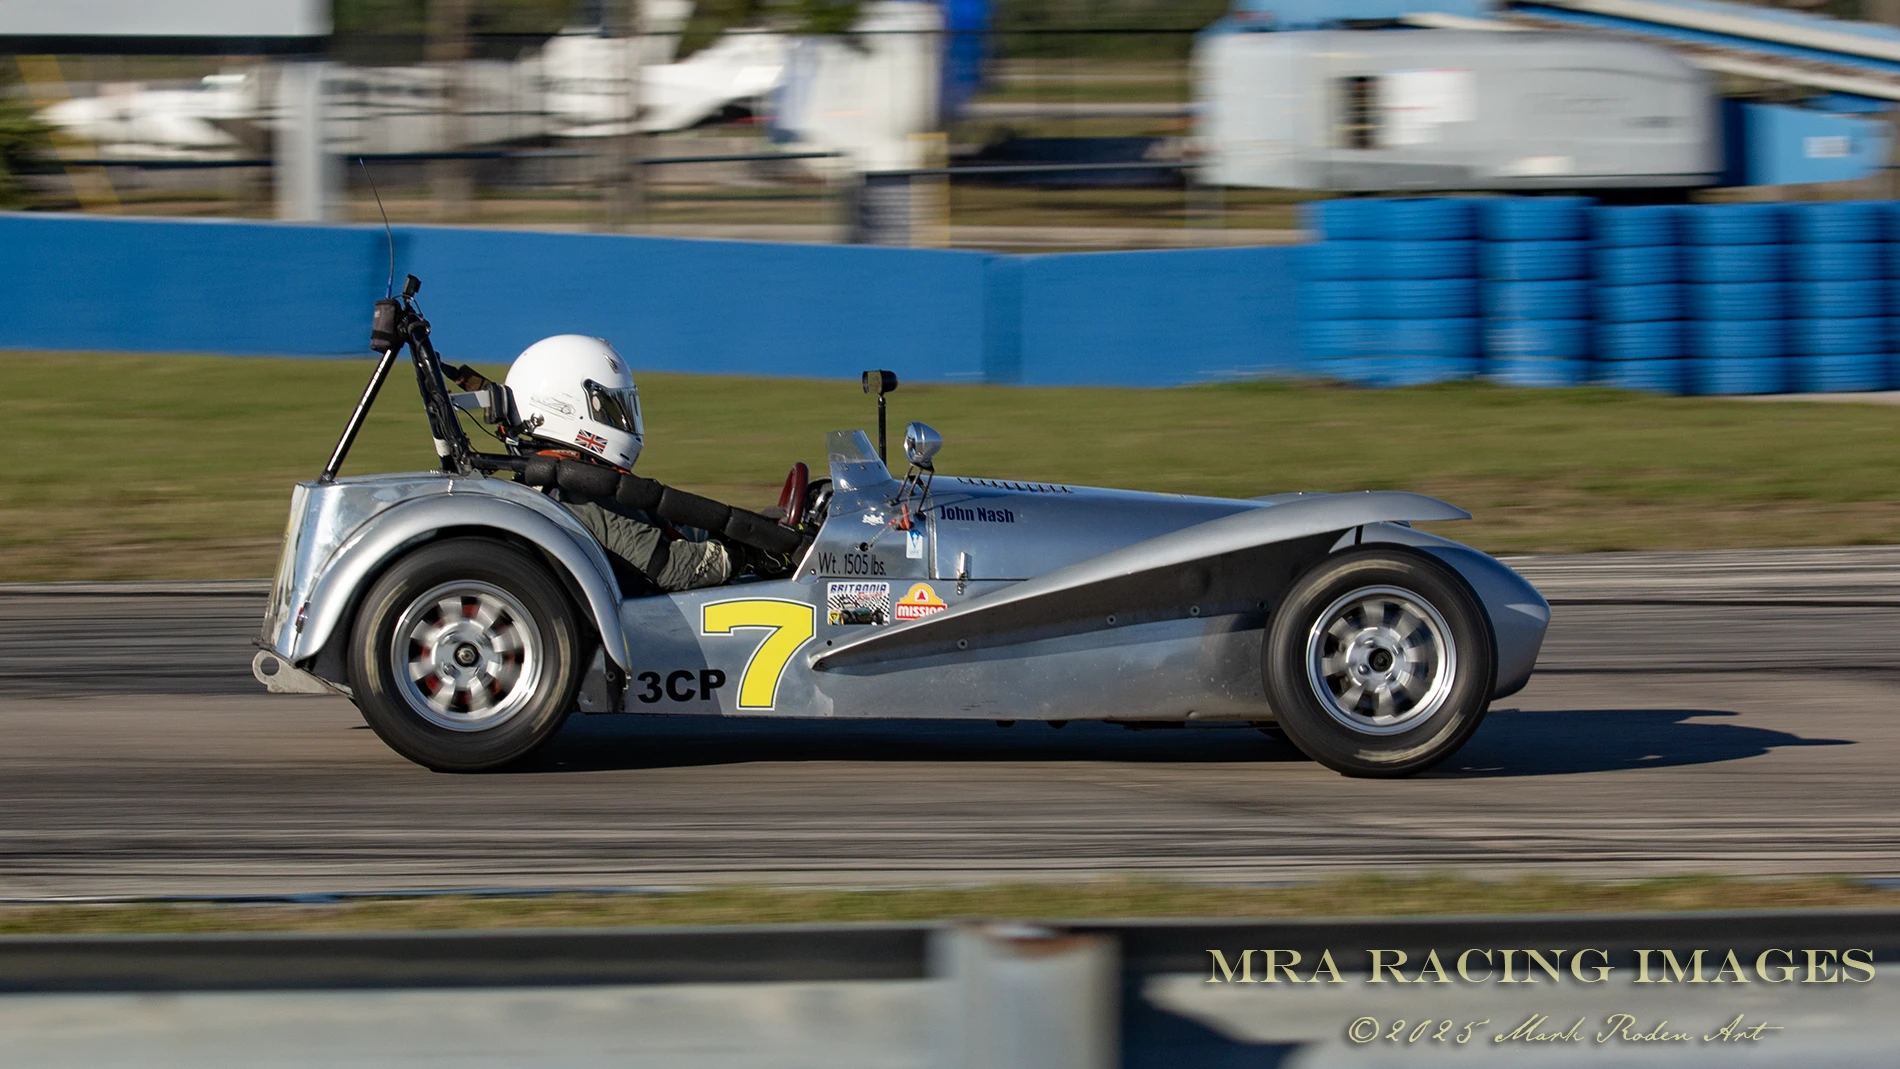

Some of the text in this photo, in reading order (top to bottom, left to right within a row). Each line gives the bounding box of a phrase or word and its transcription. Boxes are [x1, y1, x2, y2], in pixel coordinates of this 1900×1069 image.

[941, 504, 1014, 524] John Nash
[818, 551, 887, 576] Wt. 1505 lbs.
[830, 584, 887, 593] BRITANNIA
[701, 598, 816, 710] 7
[637, 669, 726, 703] 3CP
